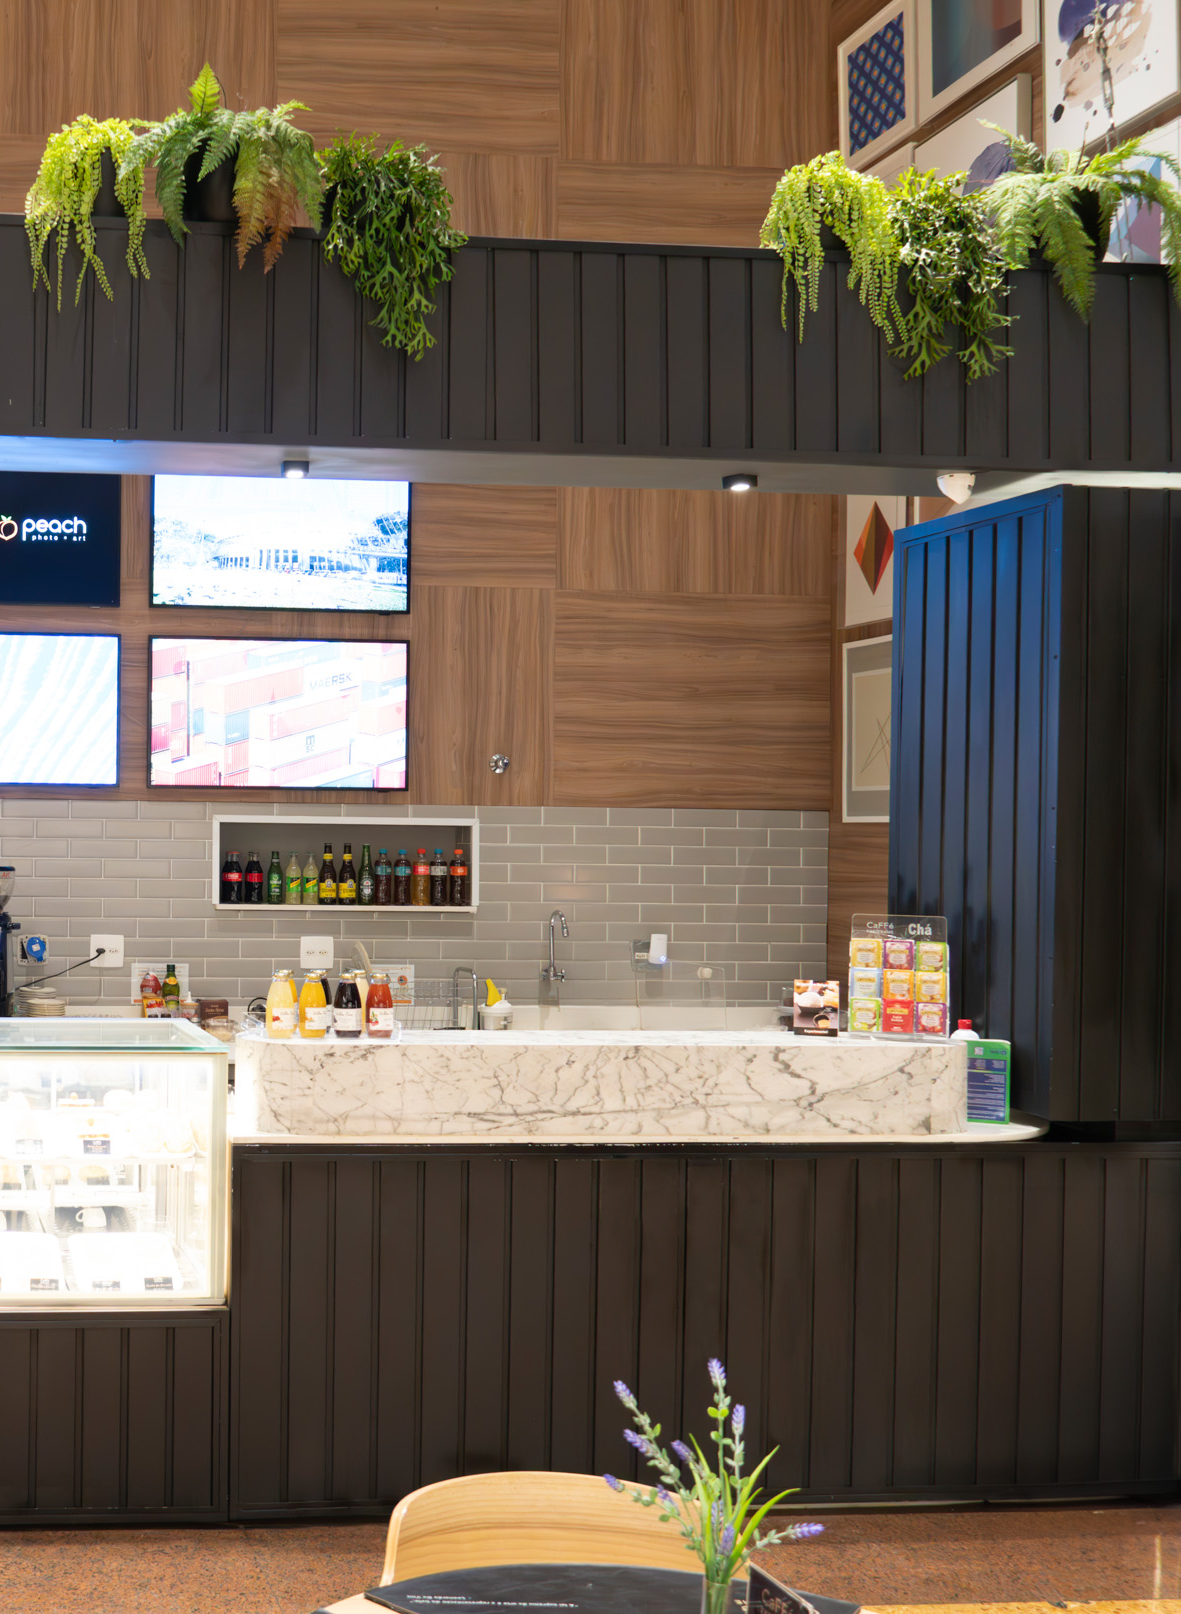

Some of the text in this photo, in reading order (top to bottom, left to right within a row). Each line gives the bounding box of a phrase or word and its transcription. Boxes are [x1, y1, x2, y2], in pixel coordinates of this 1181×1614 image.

[22, 516, 87, 541] peach
[32, 533, 59, 542] photo
[309, 671, 353, 690] MAERSK
[866, 921, 895, 930] CaFFé
[908, 923, 933, 936] Chá
